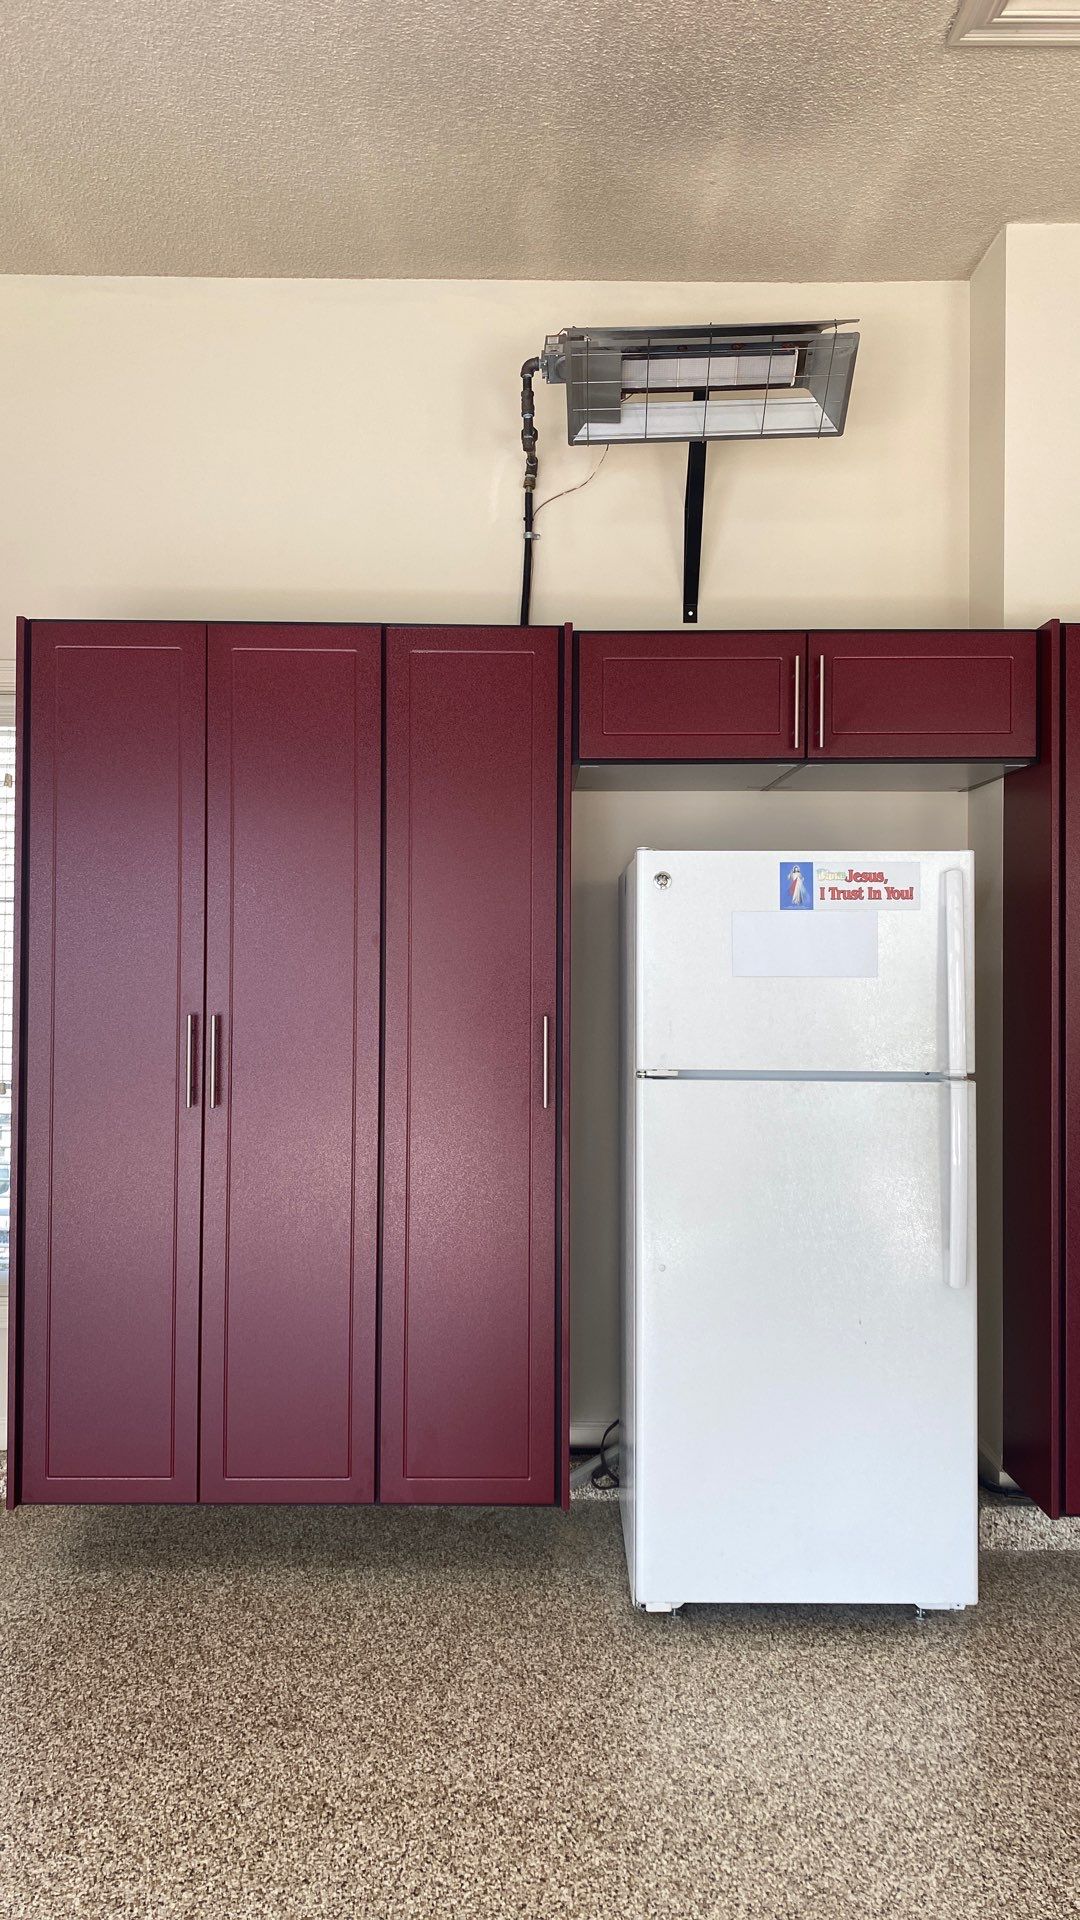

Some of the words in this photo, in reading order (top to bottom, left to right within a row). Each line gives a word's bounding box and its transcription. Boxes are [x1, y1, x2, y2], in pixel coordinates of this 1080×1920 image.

[845, 869, 888, 884] Jesus,
[819, 887, 826, 900] I
[828, 887, 864, 900] Trust
[868, 887, 882, 900] In
[884, 887, 914, 900] You!
